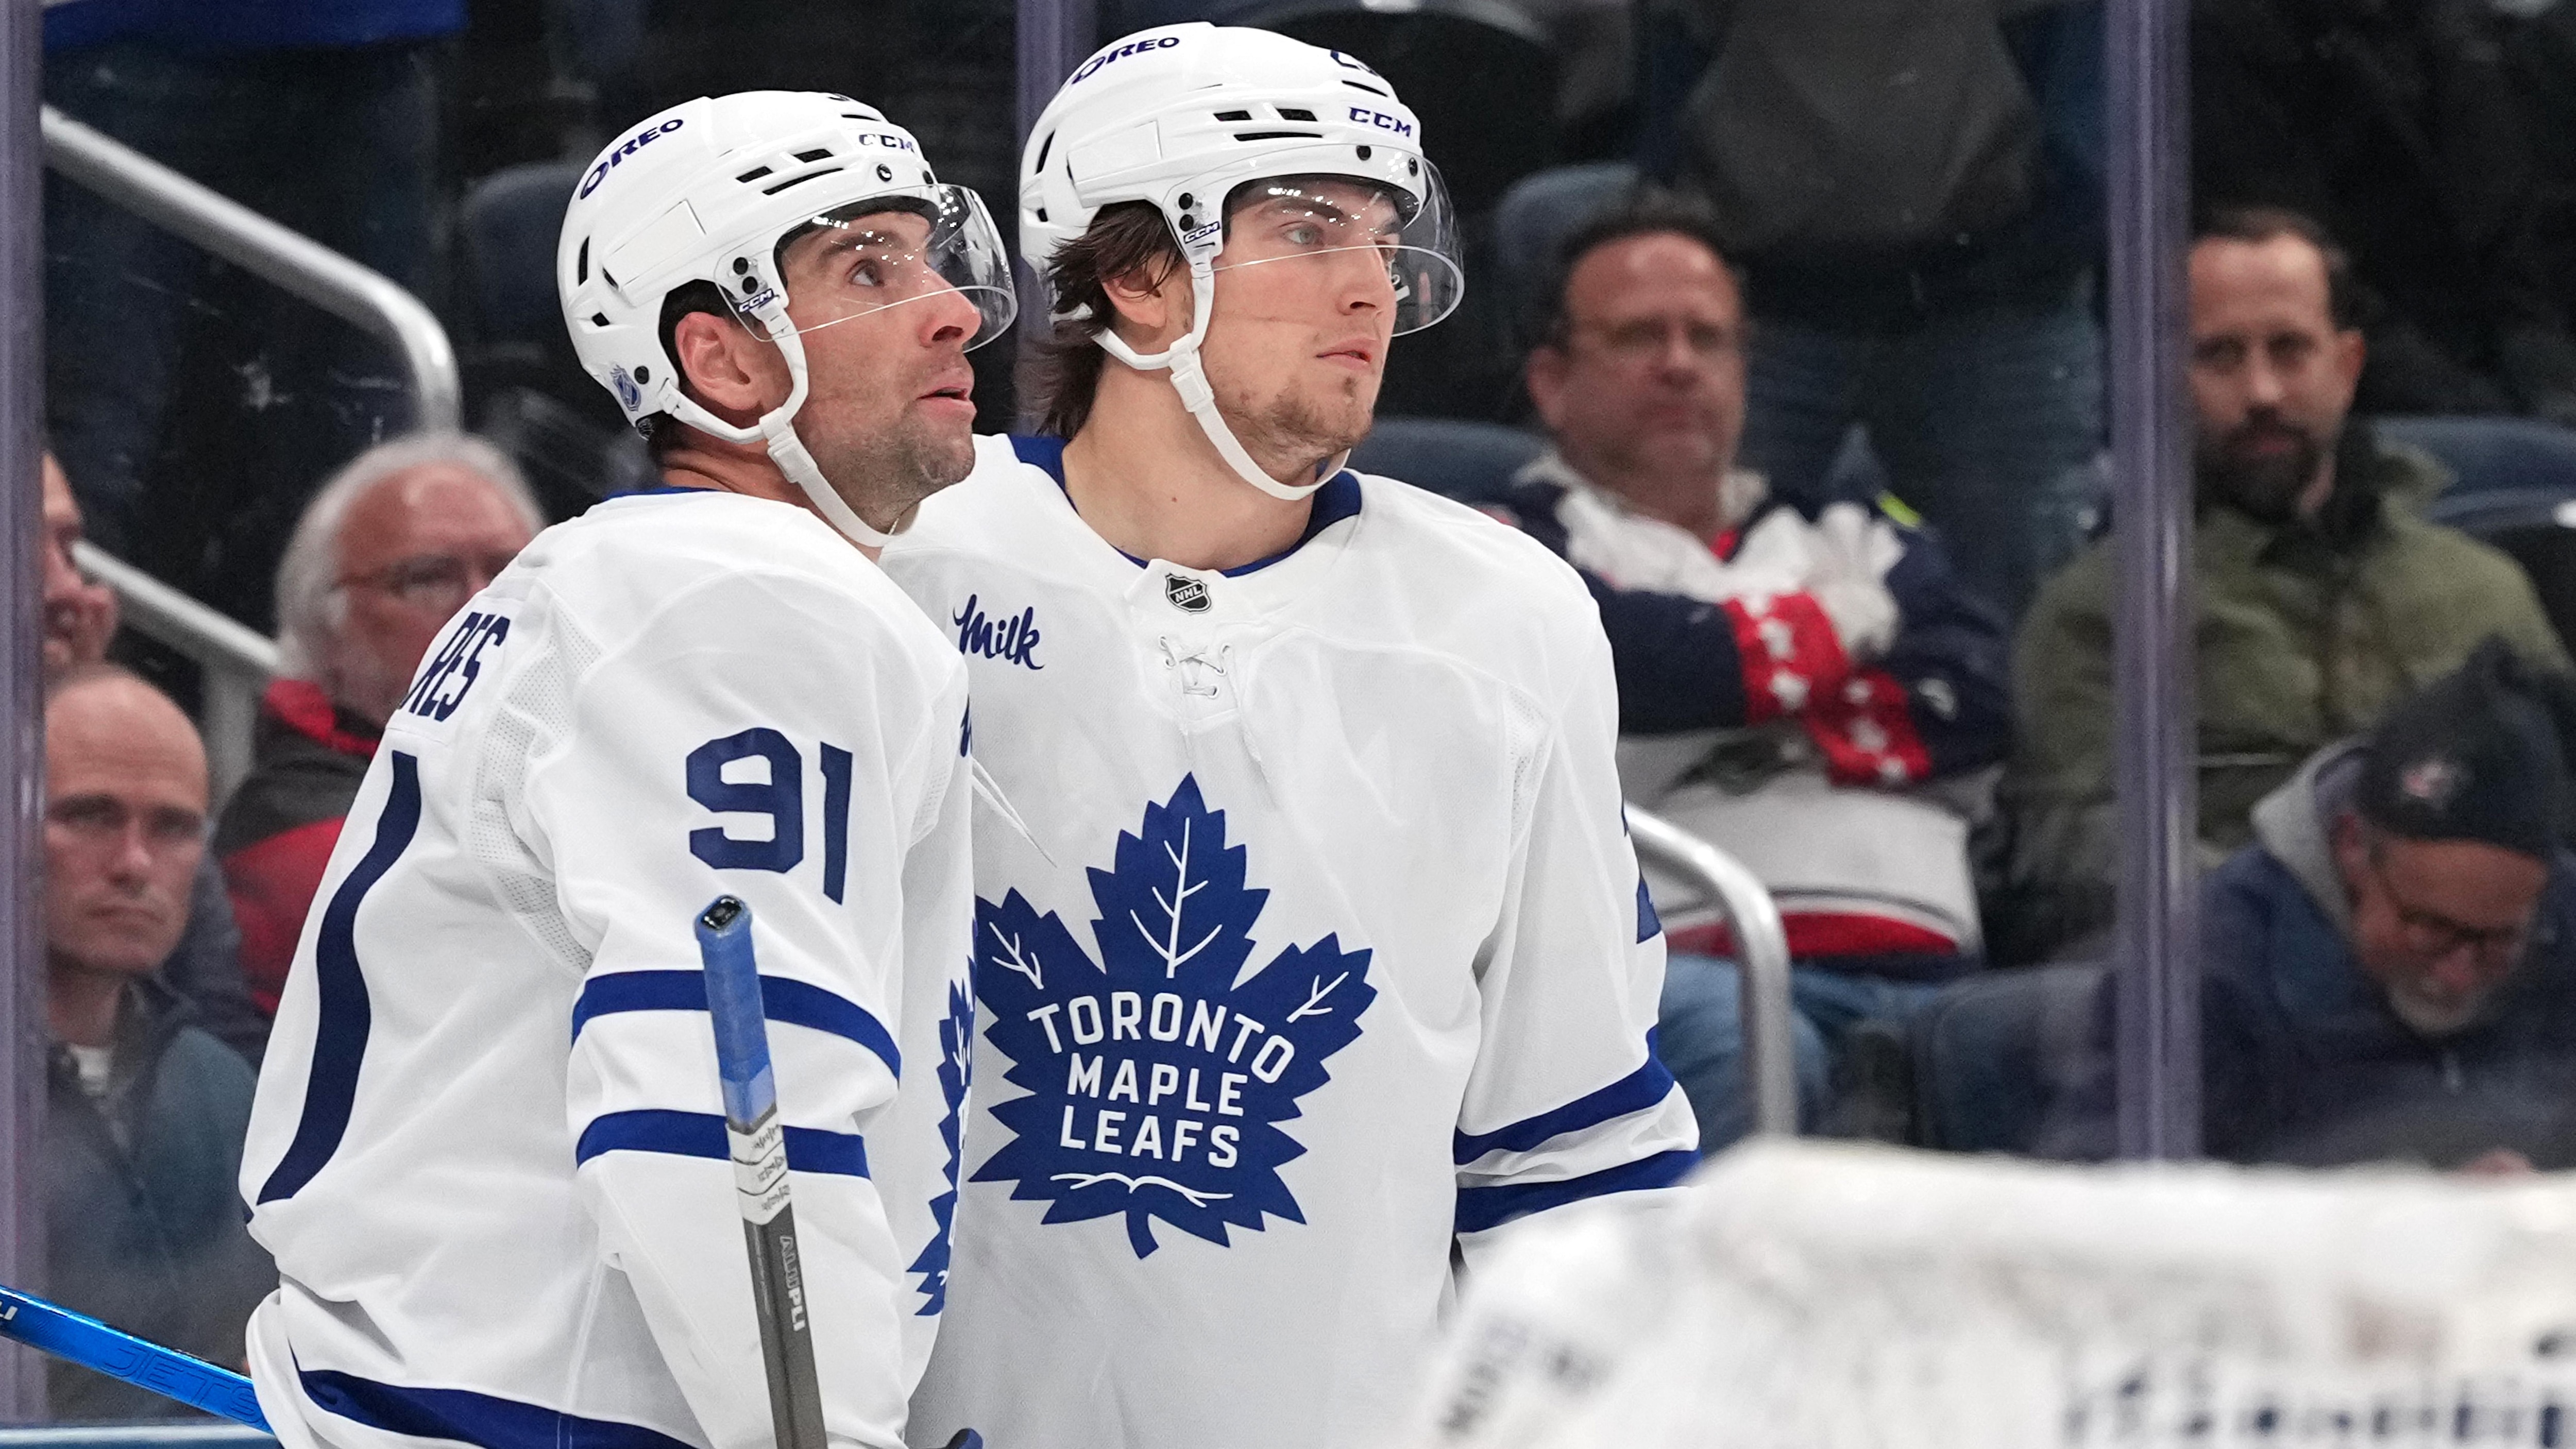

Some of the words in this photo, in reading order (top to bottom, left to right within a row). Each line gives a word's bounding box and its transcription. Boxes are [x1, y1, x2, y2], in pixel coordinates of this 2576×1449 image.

[1071, 37, 1180, 84] OREO
[859, 134, 916, 154] CCM
[1348, 107, 1411, 138] CCM
[580, 120, 683, 200] OREO
[1185, 222, 1218, 243] CCM
[739, 289, 772, 313] CCM
[1175, 586, 1202, 603] NHL
[953, 594, 1045, 670] Milk
[686, 727, 854, 906] 91
[1027, 991, 1295, 1083] TORONTO
[1067, 1052, 1248, 1116] MAPLE
[1060, 1105, 1240, 1168] LEAFS
